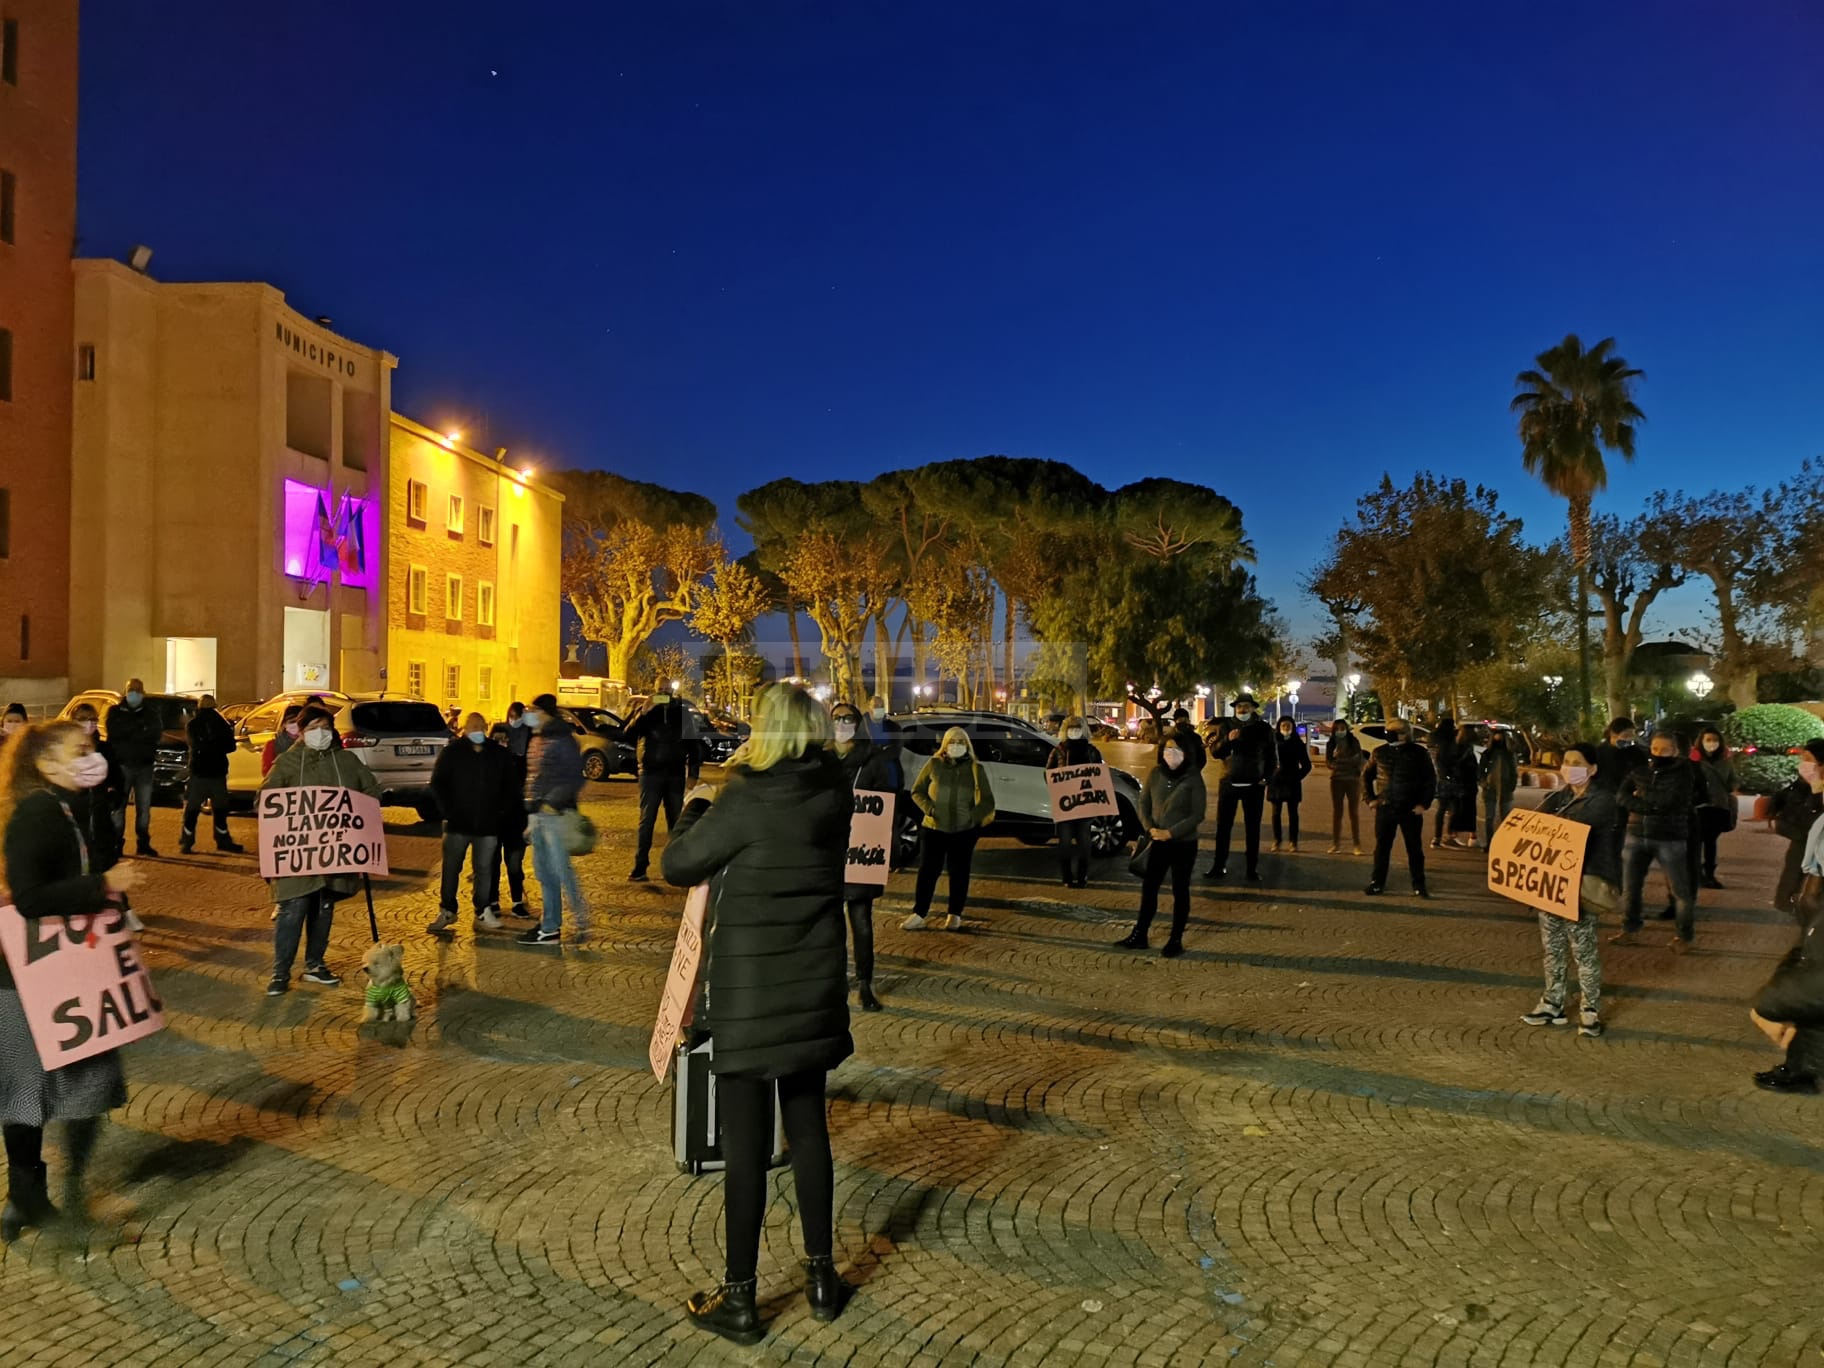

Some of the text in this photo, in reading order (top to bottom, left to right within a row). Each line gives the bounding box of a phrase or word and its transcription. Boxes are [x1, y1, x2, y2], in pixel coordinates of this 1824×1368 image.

[276, 321, 355, 377] MUNICIPIO
[263, 789, 353, 819] SENZA
[288, 813, 364, 832] LAVORO
[273, 833, 309, 848] NON
[1512, 838, 1562, 866] NON
[274, 842, 381, 874] FUTURO!!
[1491, 858, 1569, 906] SPEGNE
[113, 939, 140, 977] E
